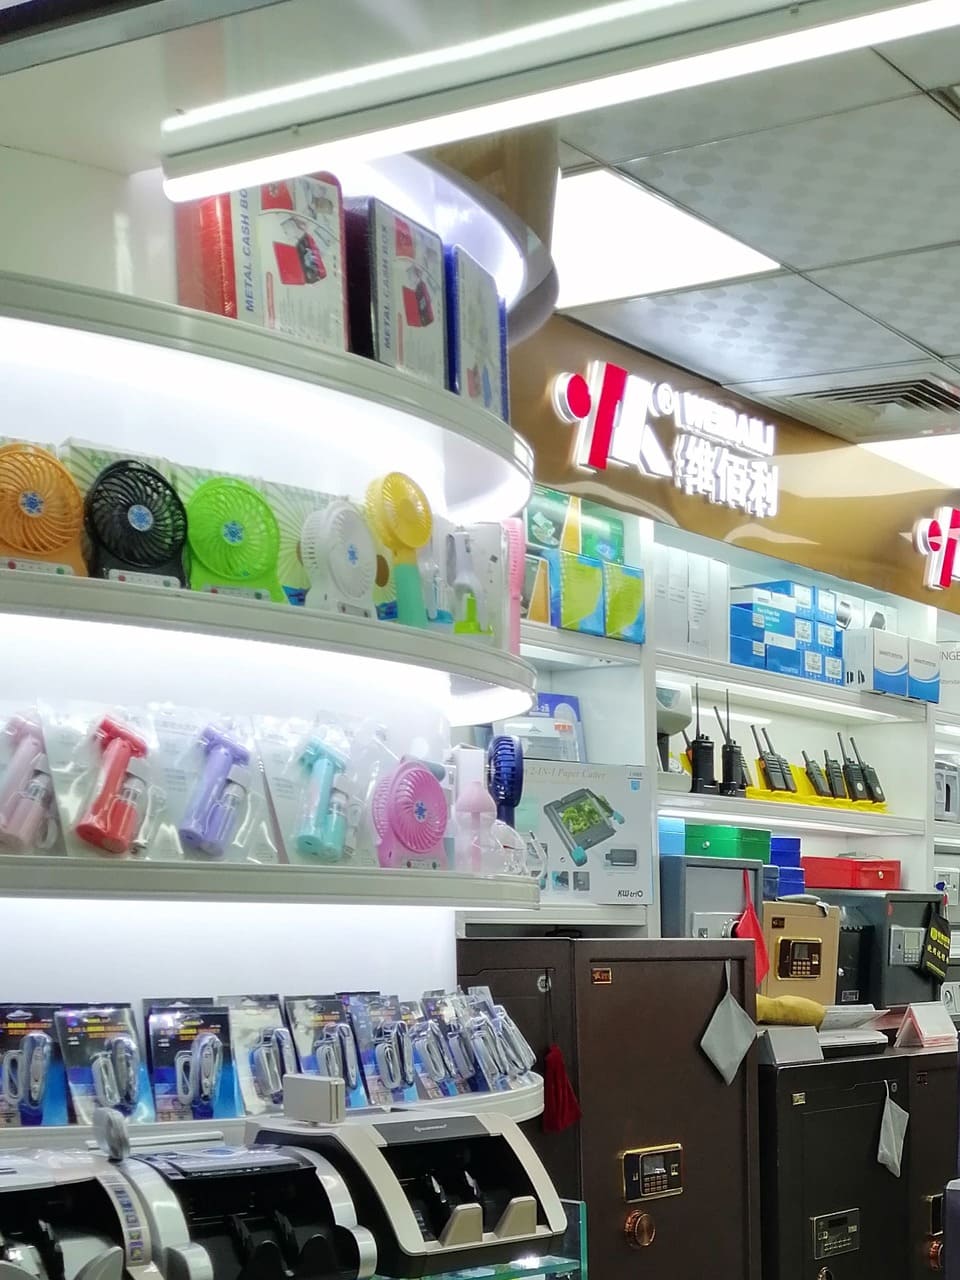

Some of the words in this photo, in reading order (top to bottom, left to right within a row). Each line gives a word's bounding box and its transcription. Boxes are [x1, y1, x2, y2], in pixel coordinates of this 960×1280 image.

[240, 211, 251, 256] CASH
[244, 259, 254, 312] METAL
[673, 434, 778, 518] 维佰利
